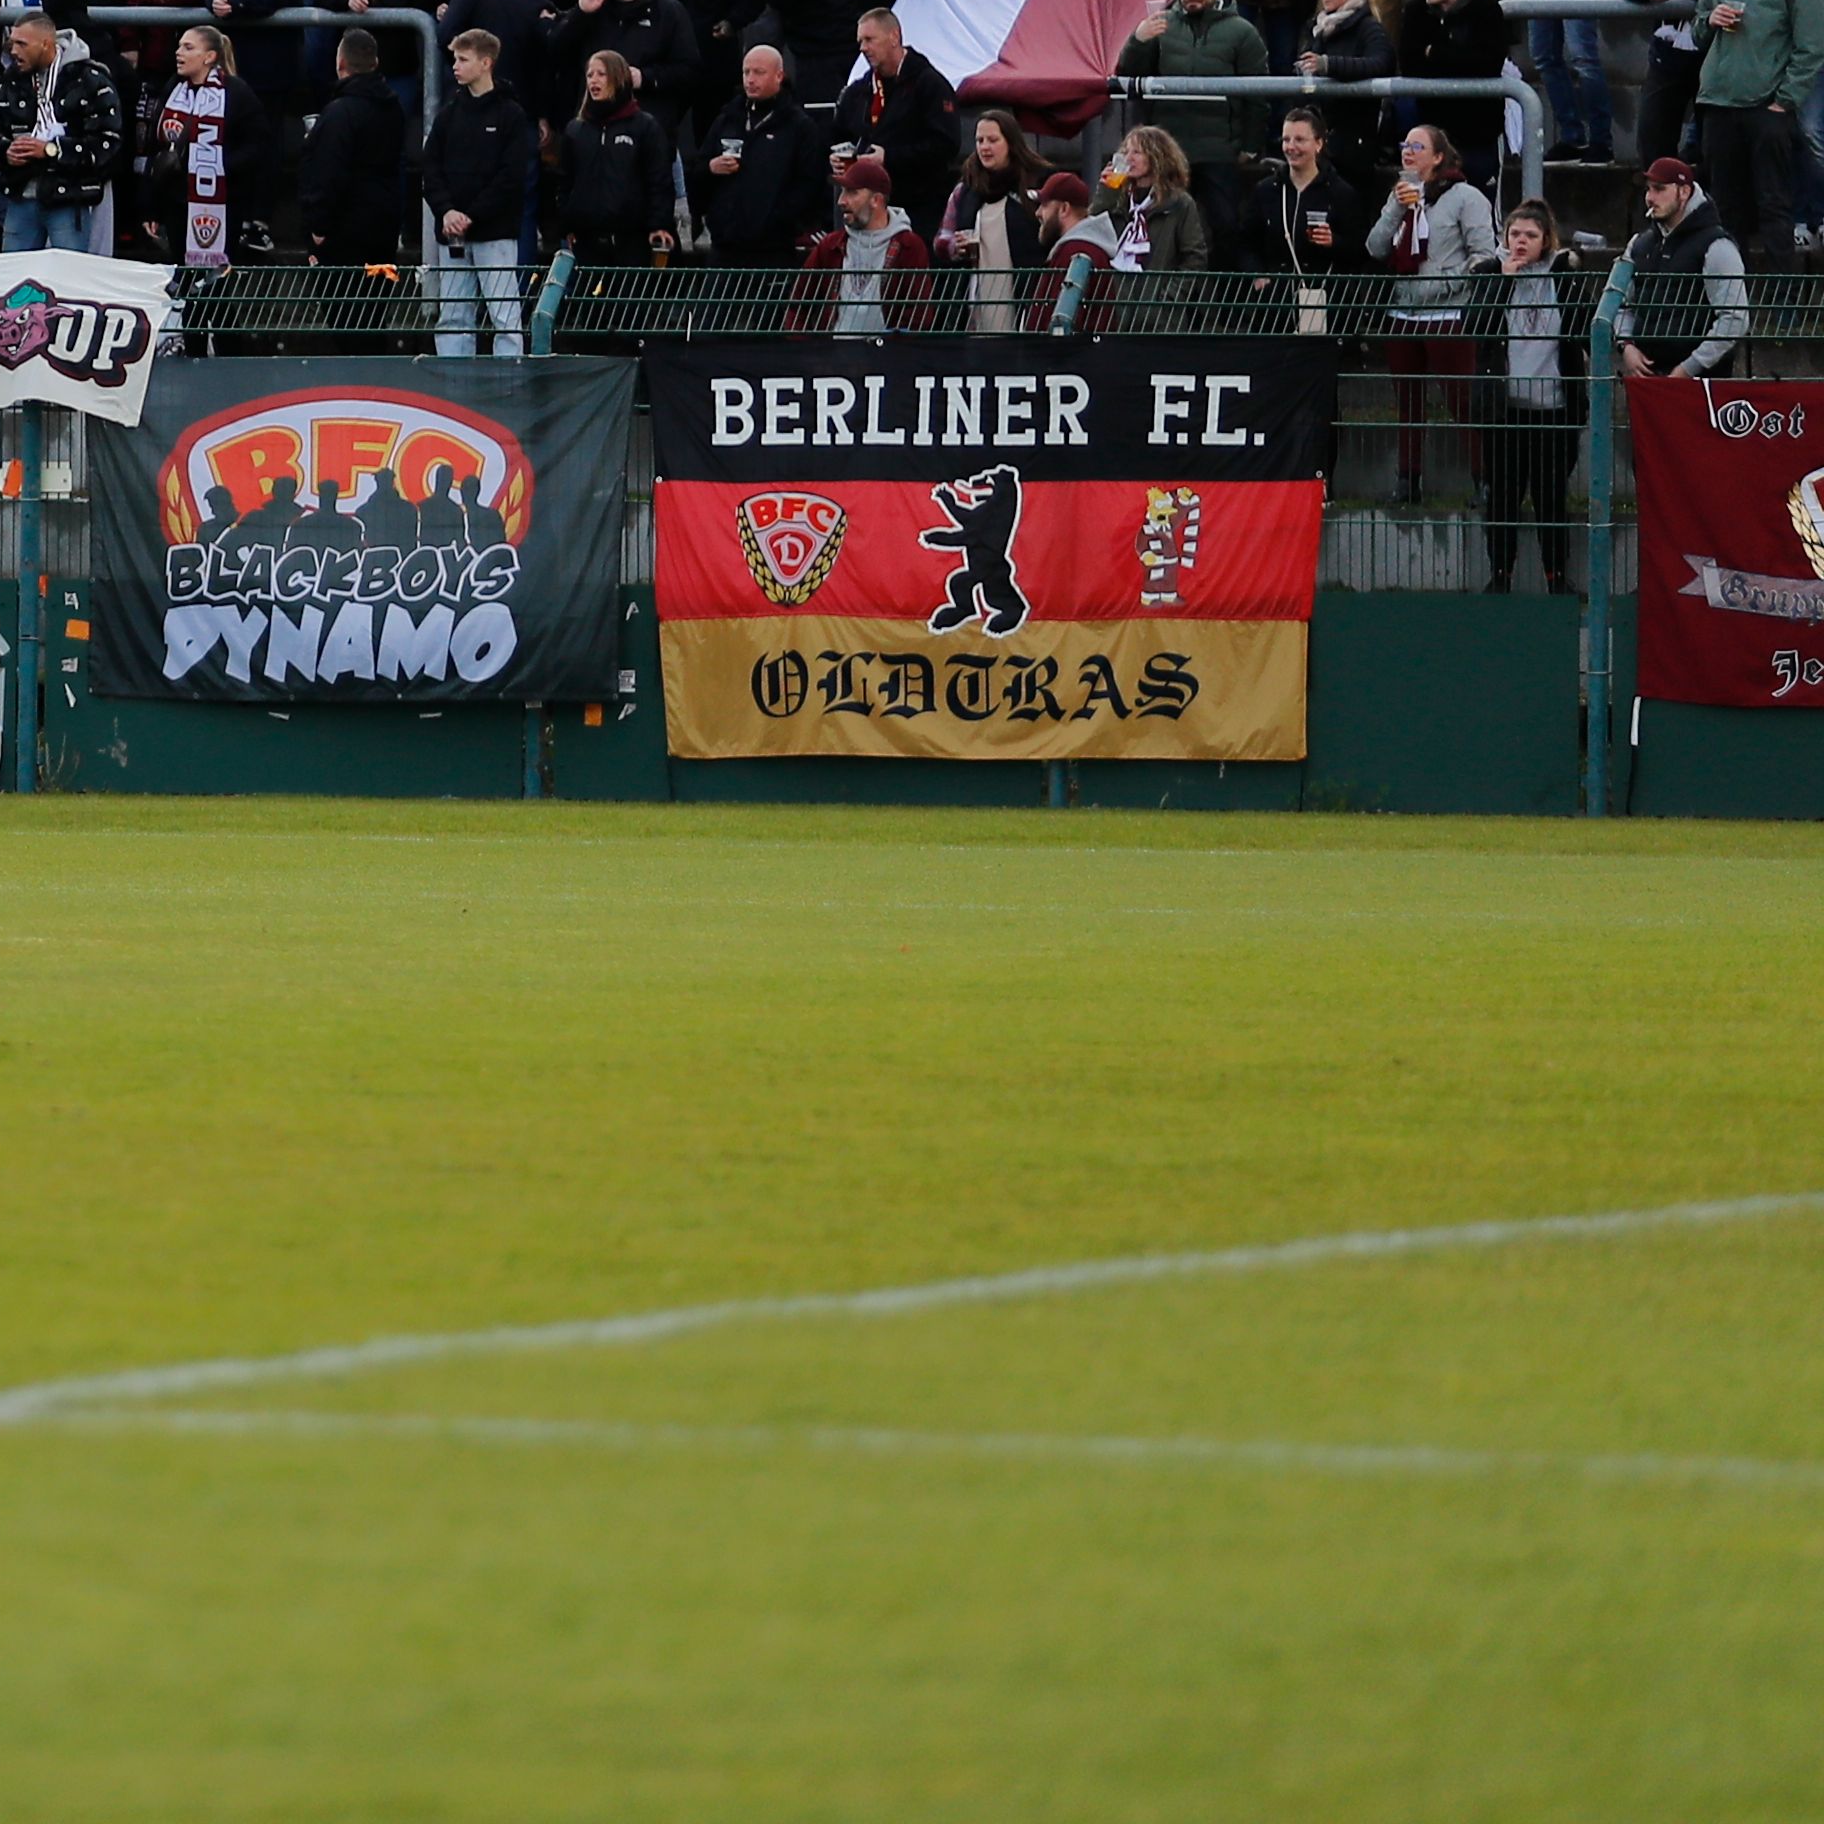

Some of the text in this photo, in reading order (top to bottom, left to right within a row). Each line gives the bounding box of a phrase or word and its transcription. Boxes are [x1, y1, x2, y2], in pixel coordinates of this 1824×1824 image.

[710, 374, 1266, 446] BERLINER F.C.
[1718, 400, 1806, 439] Ost
[206, 417, 486, 514] BFC
[750, 496, 837, 535] BFC
[166, 543, 521, 603] BLACKBOYS
[162, 602, 518, 684] DYNAMO
[751, 650, 1200, 721] OLDTRAS
